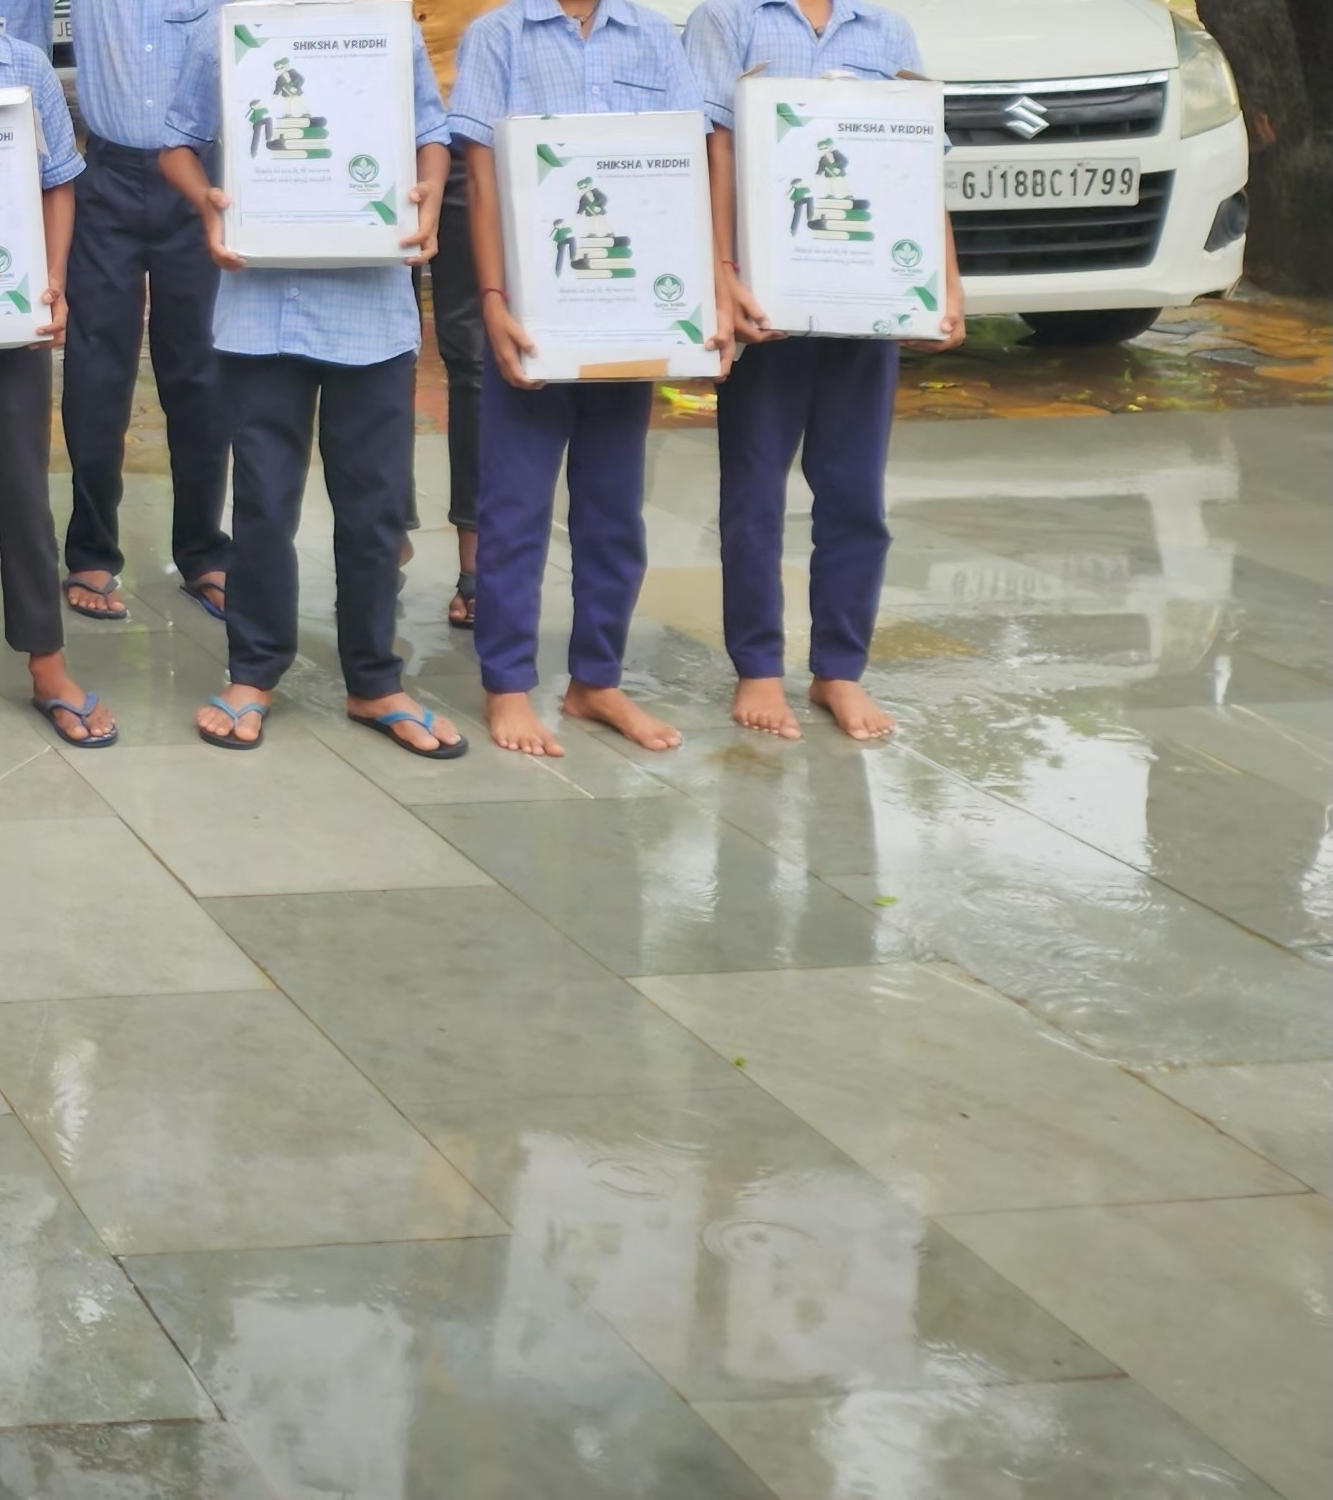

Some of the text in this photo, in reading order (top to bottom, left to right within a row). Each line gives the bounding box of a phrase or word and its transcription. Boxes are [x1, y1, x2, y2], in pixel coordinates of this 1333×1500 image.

[293, 38, 387, 51] SHIKSHA VRIDDHI
[838, 122, 934, 135] SHIKSHA VRIDDHI
[597, 158, 690, 170] SHIKSHA VRIDDHI
[963, 168, 1134, 200] GJ18BC1799
